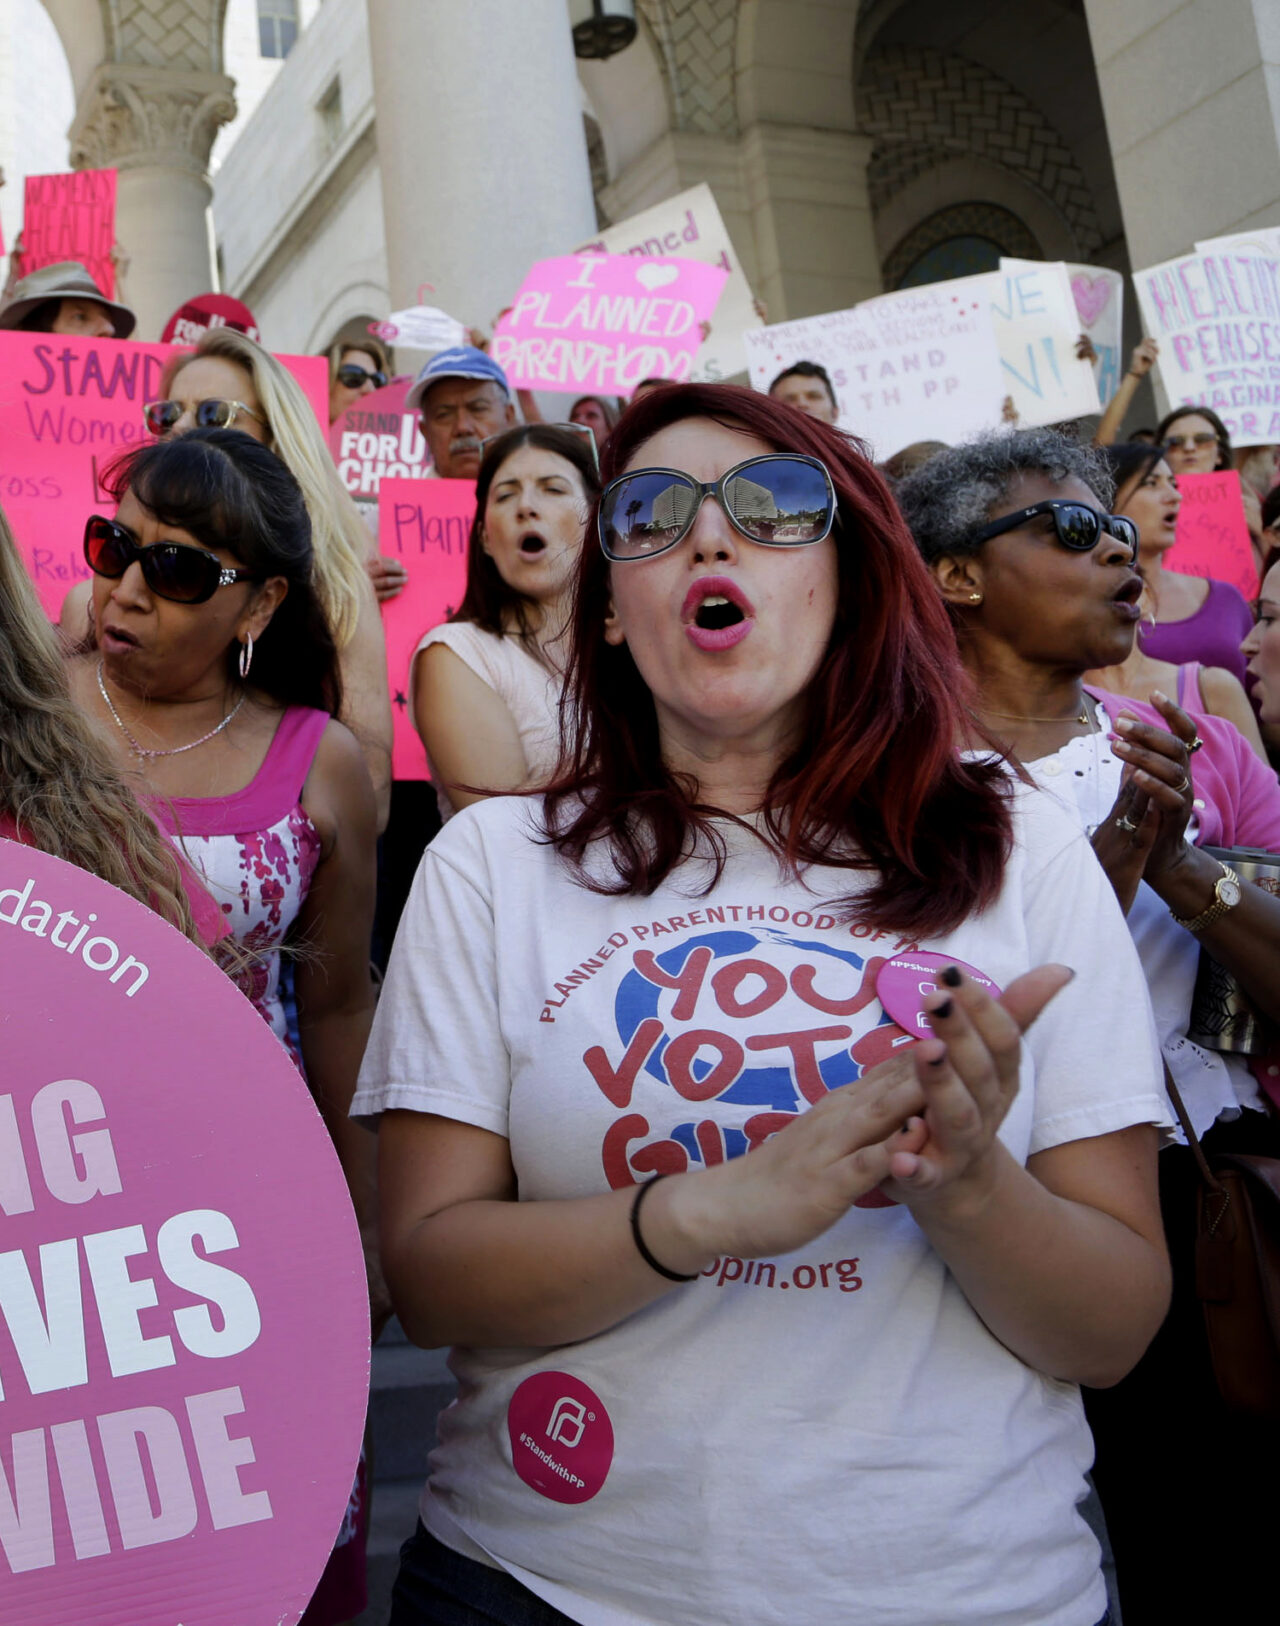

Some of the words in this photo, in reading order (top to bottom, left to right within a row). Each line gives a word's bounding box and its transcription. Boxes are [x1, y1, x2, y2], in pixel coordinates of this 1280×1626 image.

[509, 291, 695, 338] PLANNED
[833, 348, 947, 388] STAND
[345, 410, 400, 433] STAND
[839, 388, 902, 417] ITH
[340, 431, 398, 461] FOR
[539, 931, 629, 1023] PLANNED
[631, 904, 836, 941] PARENTHOOD
[849, 921, 892, 942] OF
[632, 947, 888, 1022] YOU
[518, 1431, 586, 1490] #StandwithPP
